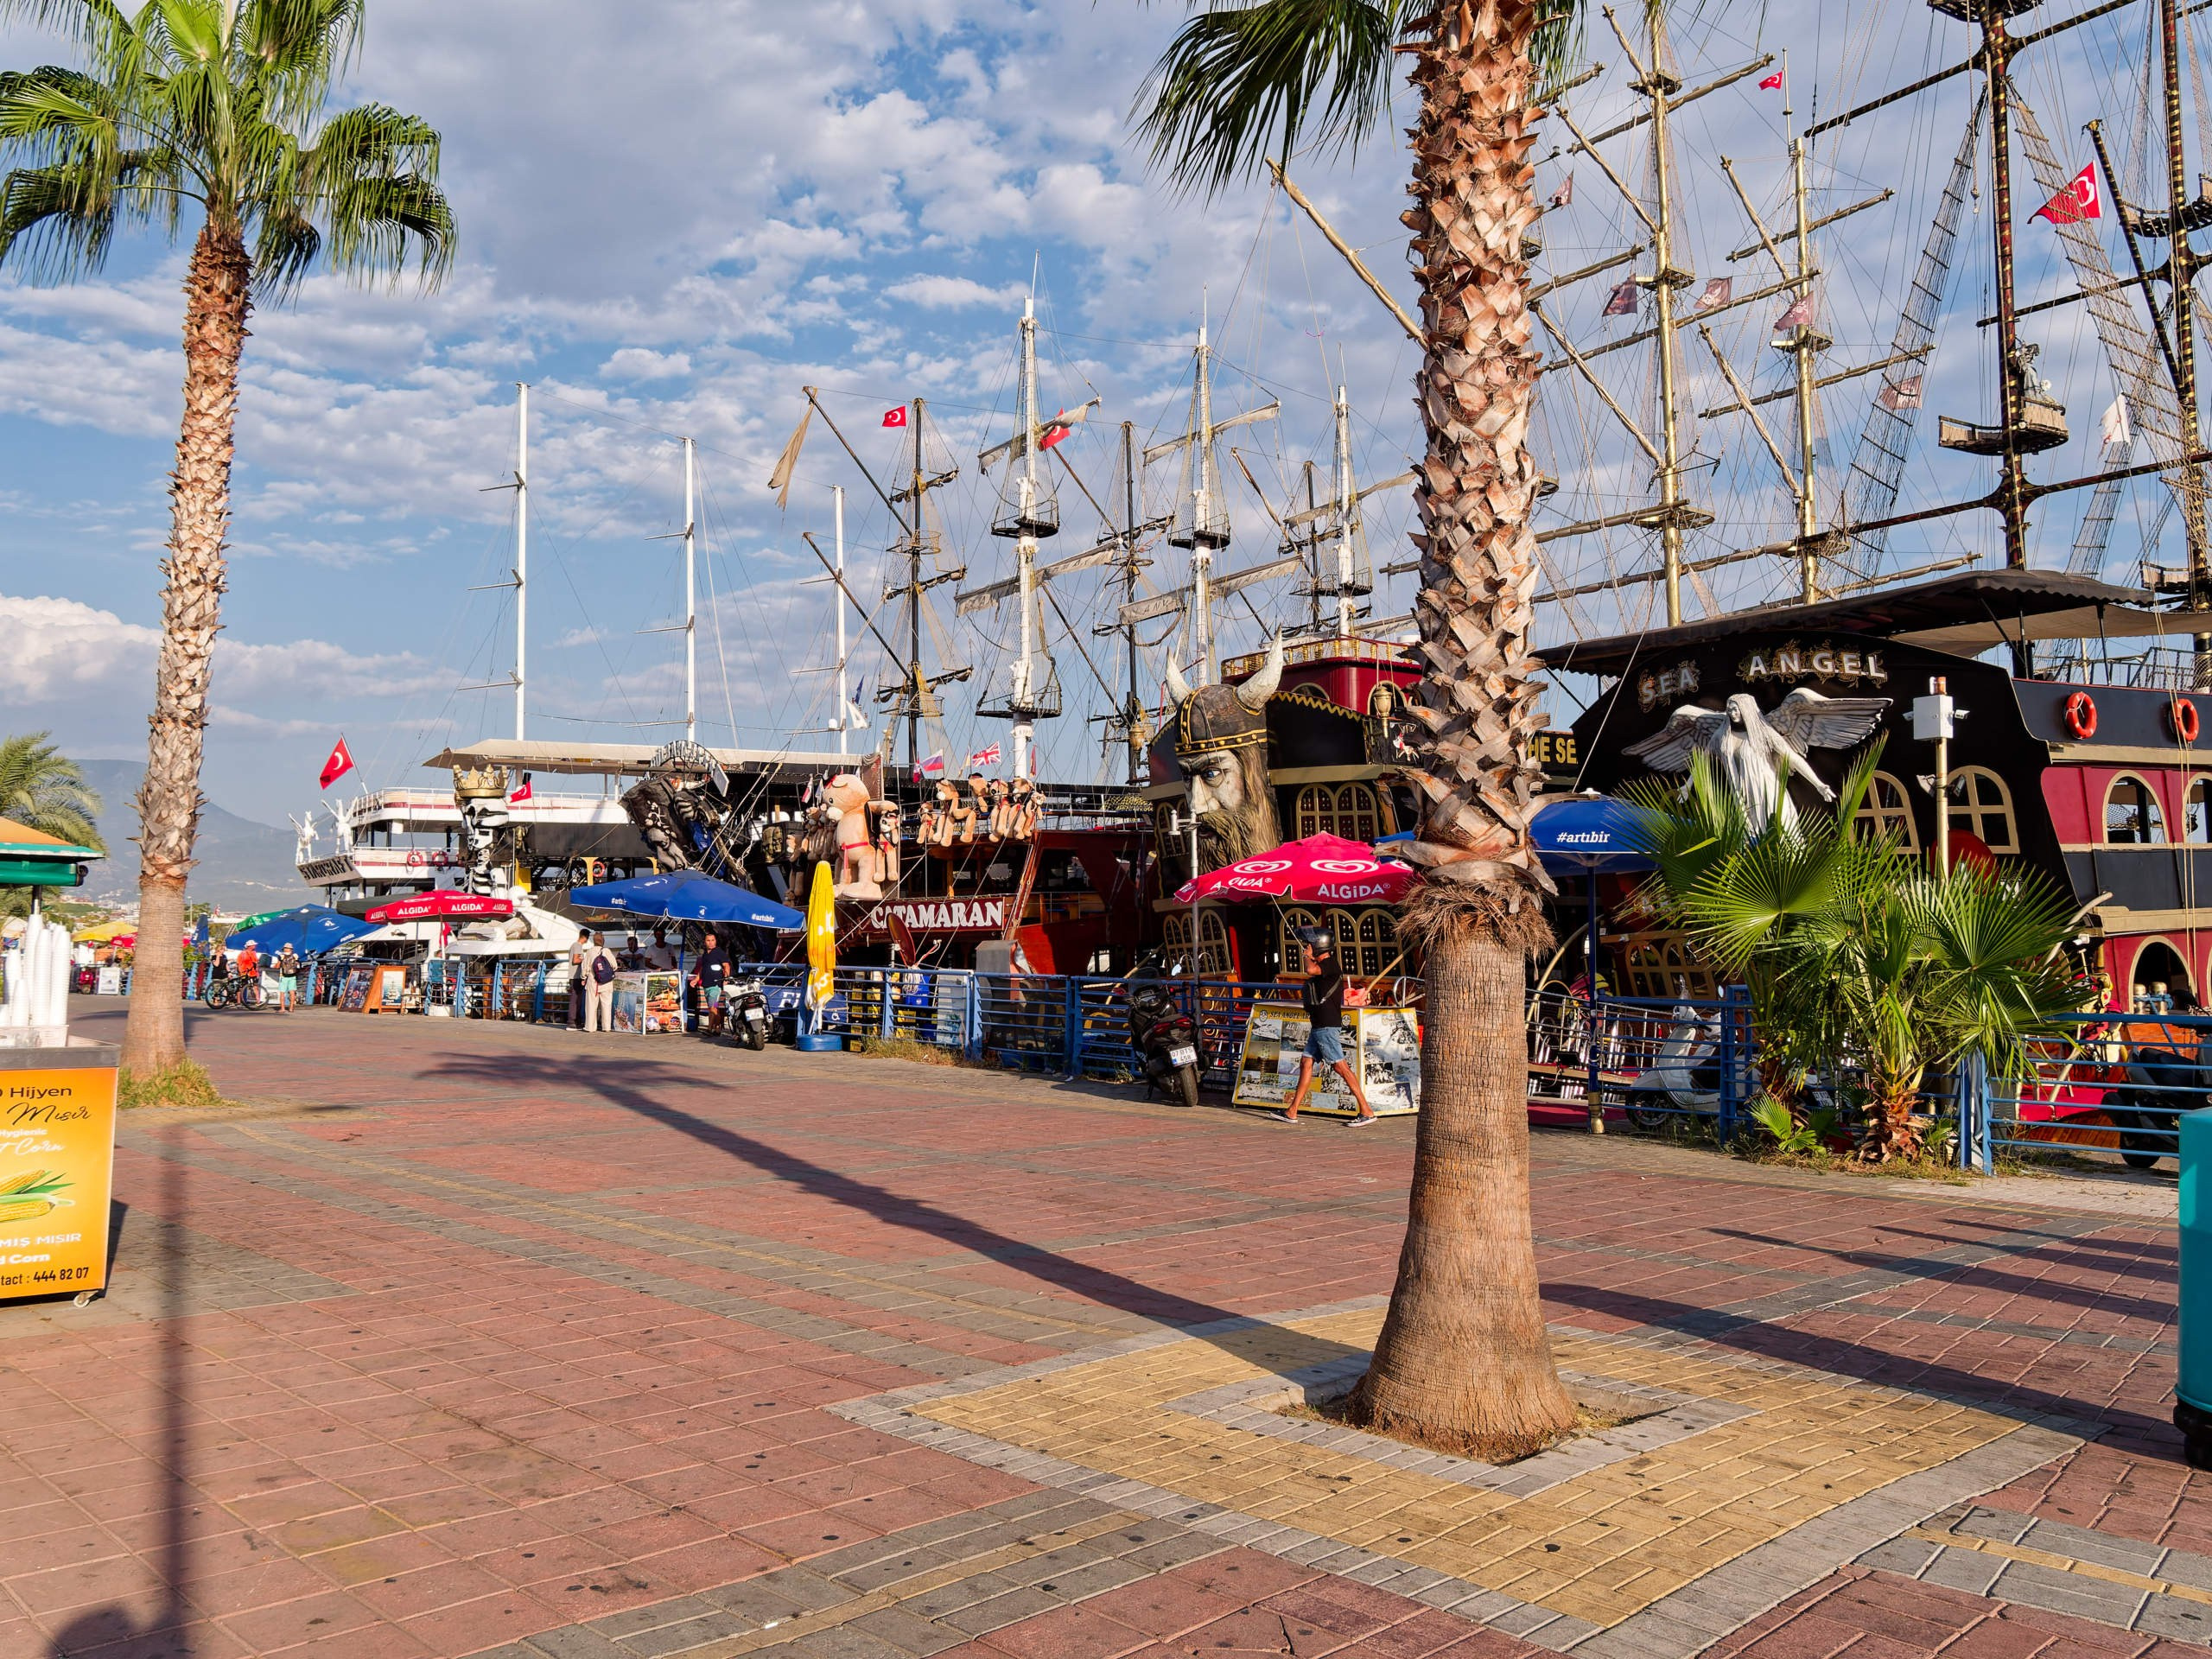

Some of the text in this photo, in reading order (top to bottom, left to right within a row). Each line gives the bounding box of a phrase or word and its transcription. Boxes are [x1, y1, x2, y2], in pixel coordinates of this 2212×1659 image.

[1641, 652, 1889, 703] SEA ANGEL
[1555, 737, 1579, 765] SE
[870, 901, 1003, 929] CATAMARAN
[10, 1086, 73, 1100] Hijyen
[9, 1254, 50, 1264] Corn
[33, 1270, 56, 1282] 444
[60, 1268, 73, 1281] 82
[76, 1267, 89, 1279] 07
